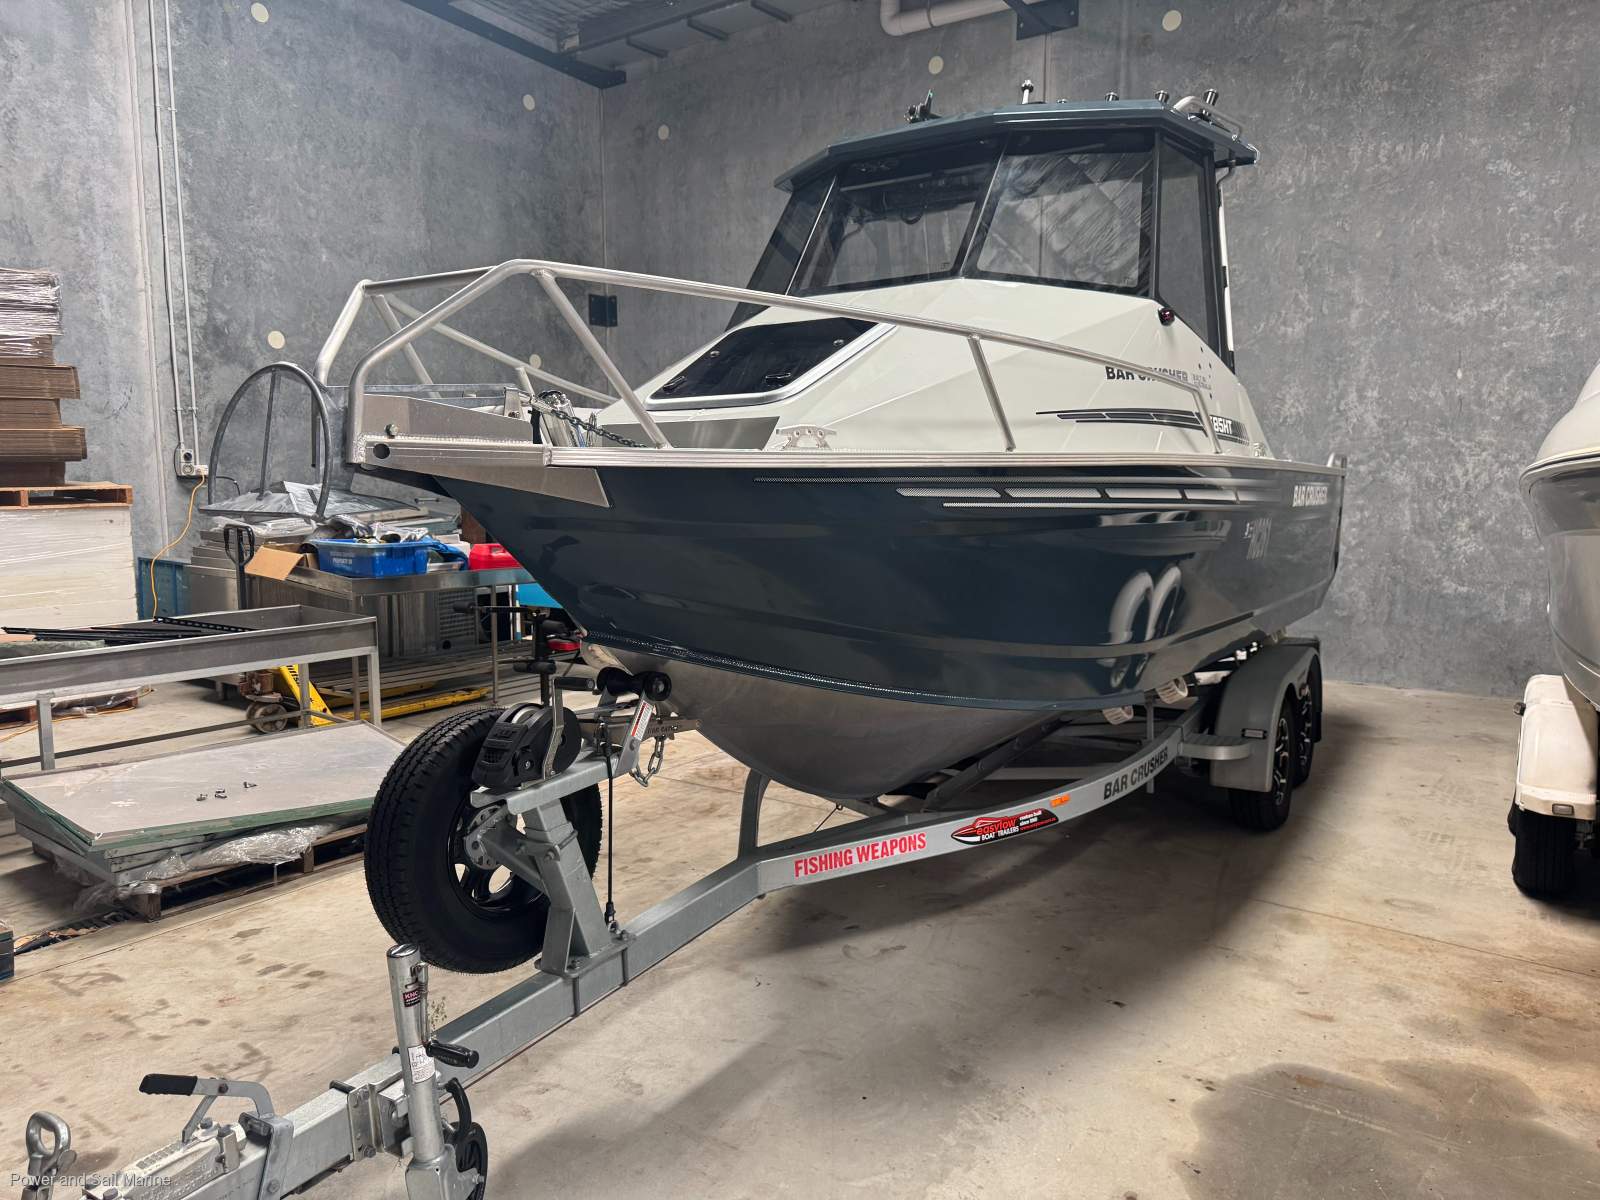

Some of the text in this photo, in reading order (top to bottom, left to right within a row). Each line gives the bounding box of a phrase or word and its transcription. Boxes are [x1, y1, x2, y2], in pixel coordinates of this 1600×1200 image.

[1210, 416, 1232, 434] 85HT
[1104, 746, 1168, 800] BAR CRUSHER
[981, 825, 1020, 841] BOAT TRAILERS
[794, 833, 927, 877] FISHING WEAPONS
